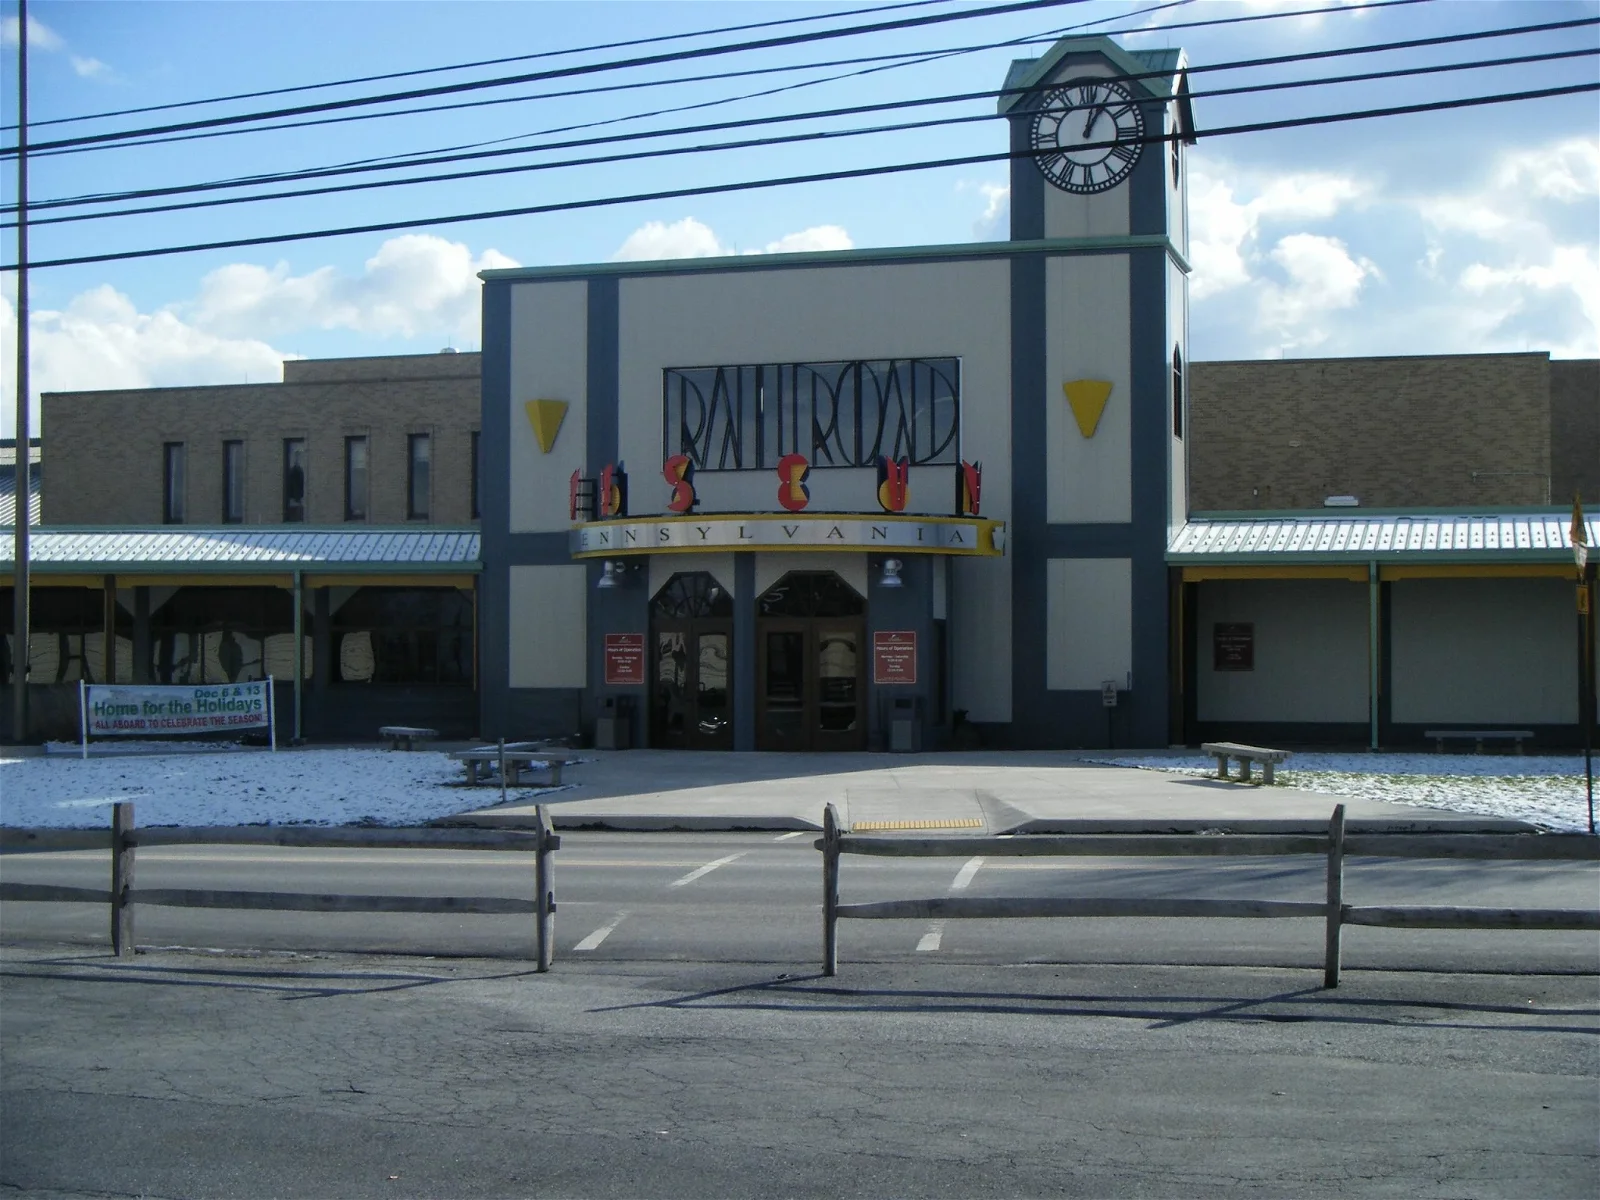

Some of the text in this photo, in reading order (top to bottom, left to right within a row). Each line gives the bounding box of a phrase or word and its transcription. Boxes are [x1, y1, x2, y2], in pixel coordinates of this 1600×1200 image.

[664, 358, 959, 471] RAILROAD
[581, 524, 964, 546] ENNSYLVANIA
[194, 685, 261, 698] Dec 6 & 13
[94, 697, 263, 717] Home for the Holidays
[95, 713, 263, 729] ALL ABOARD TO CELEBRATE THE SEASON!
